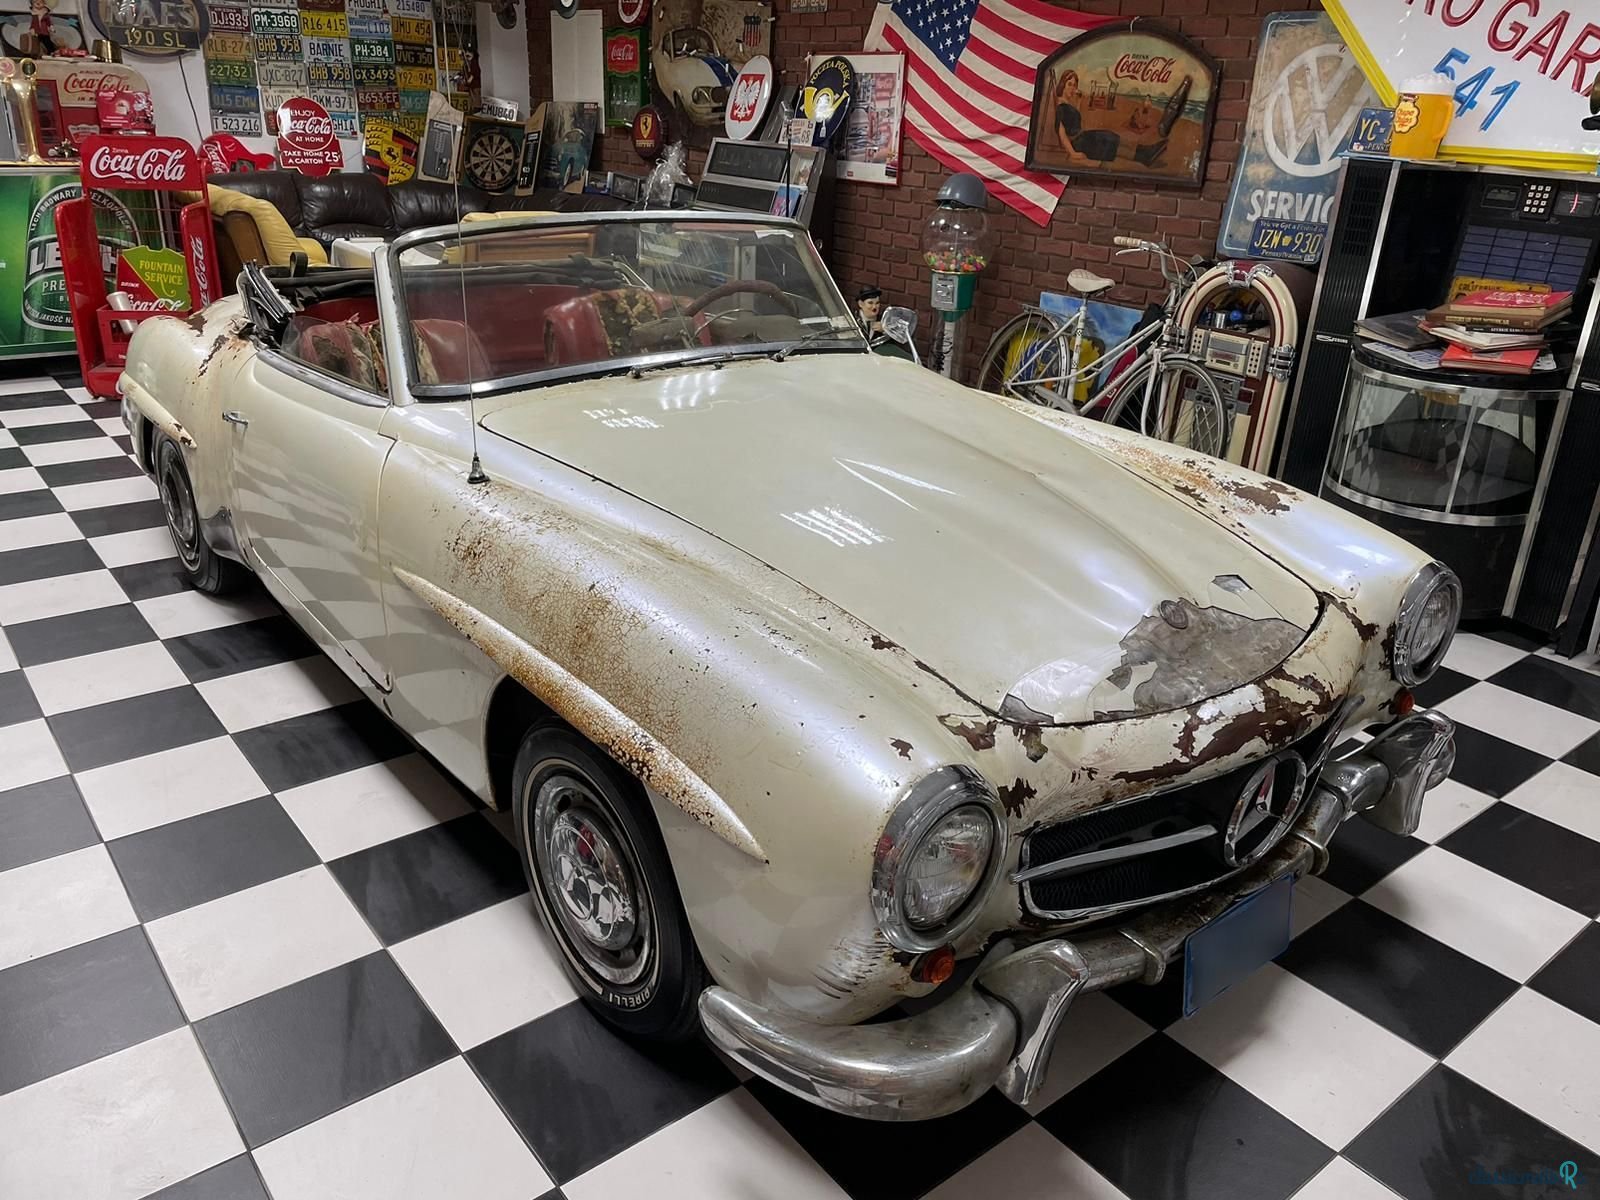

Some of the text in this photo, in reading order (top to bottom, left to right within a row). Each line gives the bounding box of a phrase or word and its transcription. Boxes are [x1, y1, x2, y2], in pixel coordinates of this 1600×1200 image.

[163, 31, 186, 48] SL
[309, 41, 344, 57] BARNIE
[1487, 0, 1594, 98] GAR
[810, 60, 851, 88] POCZTA POLSKA
[1114, 53, 1176, 84] Coca-Cola
[1433, 47, 1521, 132] 541
[290, 108, 316, 117] ENJOY
[222, 117, 241, 131] 523
[241, 119, 260, 132] 216
[304, 136, 325, 144] HOME
[295, 157, 324, 165] CARTON
[303, 150, 324, 158] HOME
[90, 145, 186, 183] Coca-Cola
[39, 188, 78, 215] BROWARY
[1291, 231, 1324, 255] 930
[29, 241, 118, 276] LEH
[139, 259, 184, 275] FOUNTAIN
[144, 271, 184, 286] SERVICE
[609, 988, 650, 1008] PIRELLI
